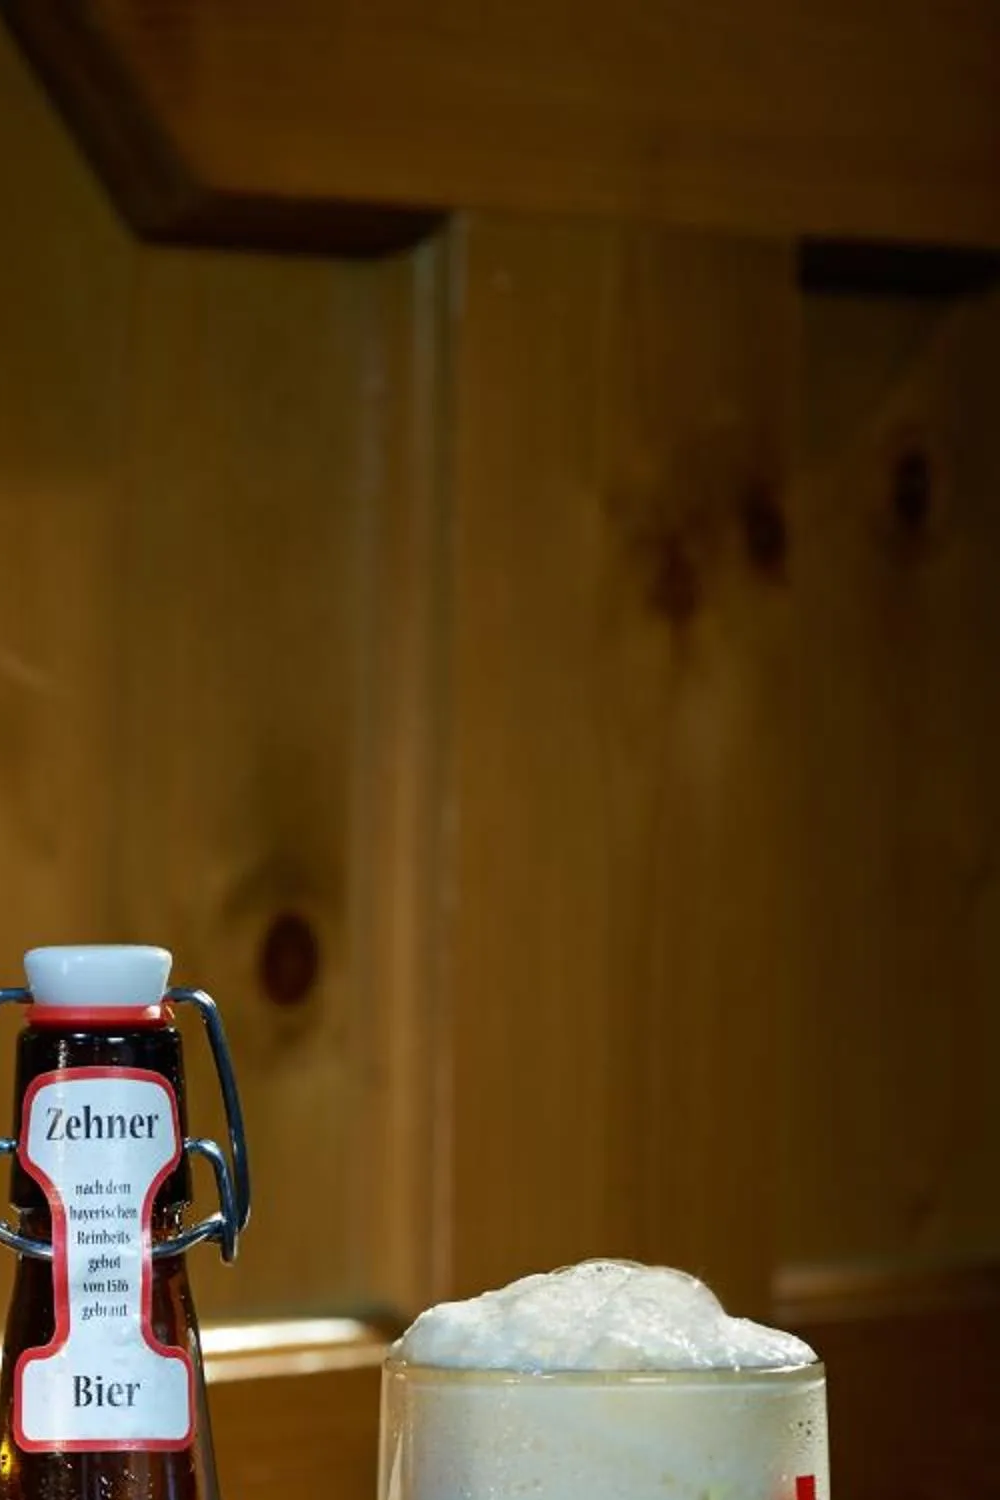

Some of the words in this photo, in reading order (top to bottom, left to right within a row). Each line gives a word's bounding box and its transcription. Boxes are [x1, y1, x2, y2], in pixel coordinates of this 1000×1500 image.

[46, 1105, 159, 1141] Zehner
[75, 1179, 104, 1195] nach
[87, 1254, 121, 1273] gebot
[83, 1282, 105, 1293] von
[73, 1375, 141, 1408] Bier
